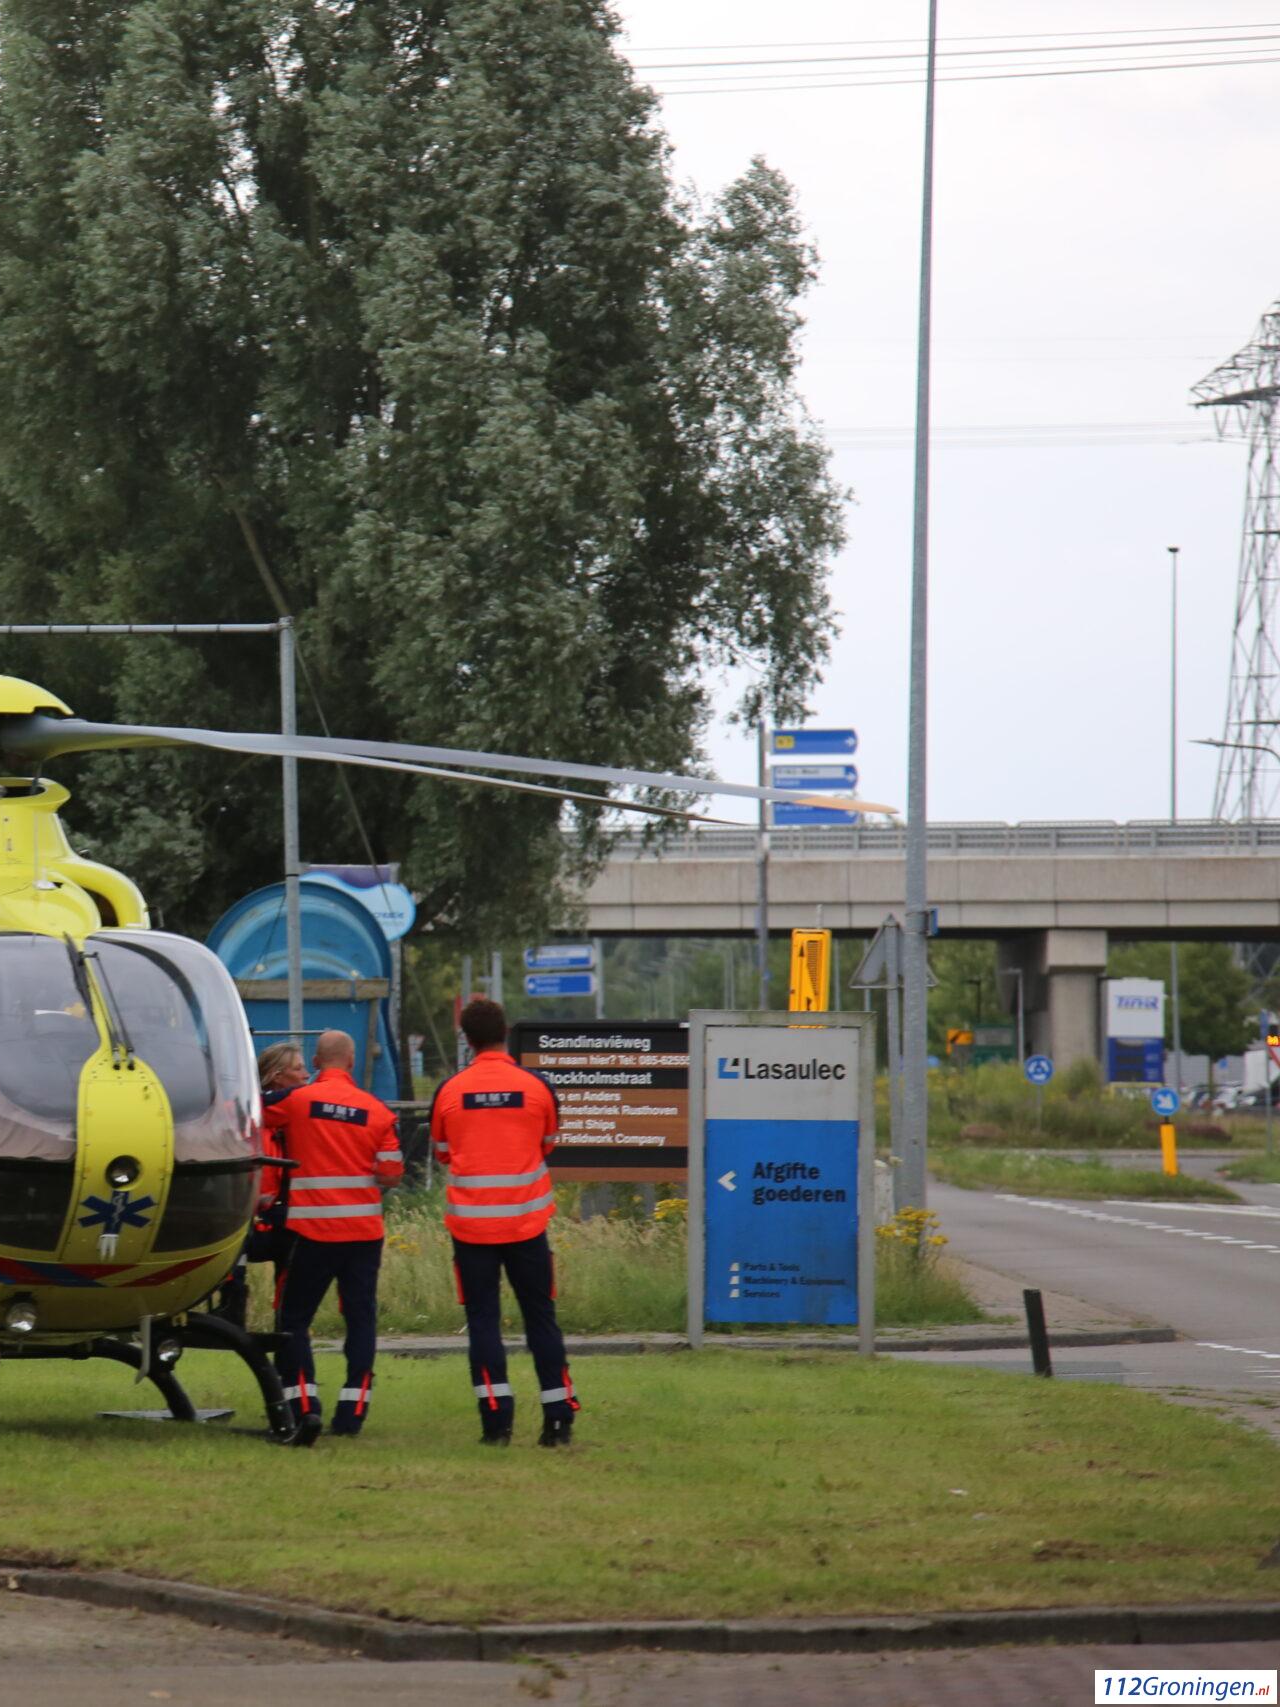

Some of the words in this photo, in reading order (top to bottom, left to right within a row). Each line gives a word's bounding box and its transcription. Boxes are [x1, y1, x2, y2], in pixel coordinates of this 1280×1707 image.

[538, 1034, 651, 1051] Scandinaviëweg
[744, 1058, 846, 1080] Lasaulec
[614, 1133, 666, 1146] Company
[753, 1162, 820, 1183] Afgifte
[752, 1185, 846, 1205] goederen
